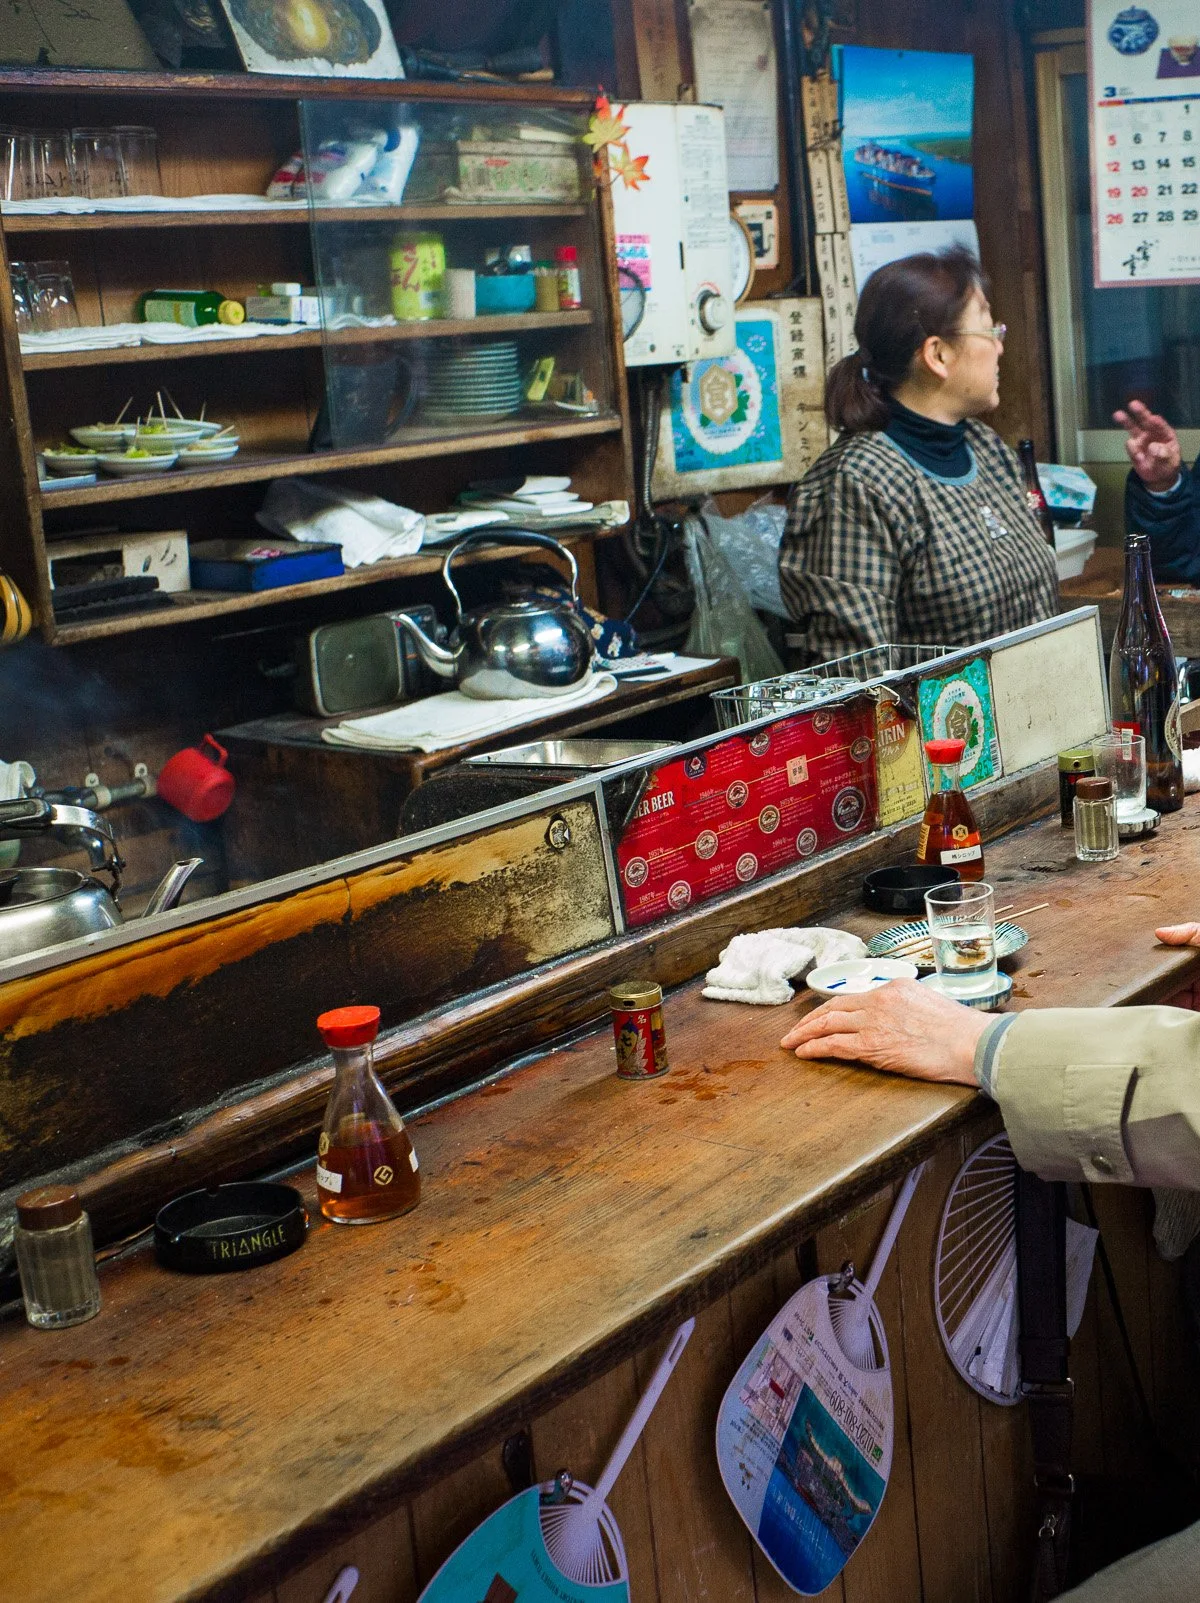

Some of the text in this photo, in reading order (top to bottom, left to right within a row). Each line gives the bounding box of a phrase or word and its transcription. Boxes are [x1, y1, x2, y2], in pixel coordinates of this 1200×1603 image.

[1104, 86, 1116, 97] 3
[1183, 104, 1191, 114] 1
[1108, 135, 1116, 146] 5
[1133, 133, 1142, 144] 6
[1158, 131, 1167, 143] 7
[1183, 130, 1192, 141] 8
[1106, 161, 1120, 173] 12
[1131, 159, 1146, 171] 13
[1156, 157, 1171, 169] 14
[1182, 156, 1195, 168] 15
[1107, 188, 1121, 199] 19
[1131, 186, 1148, 197] 20
[1157, 184, 1173, 196] 21
[1181, 183, 1198, 195] 22
[1106, 213, 1124, 225] 26
[1132, 211, 1149, 224] 27
[1157, 210, 1174, 222] 28
[1182, 209, 1198, 222] 29
[651, 791, 675, 812] BEER
[829, 1389, 875, 1453] 0120-801-809
